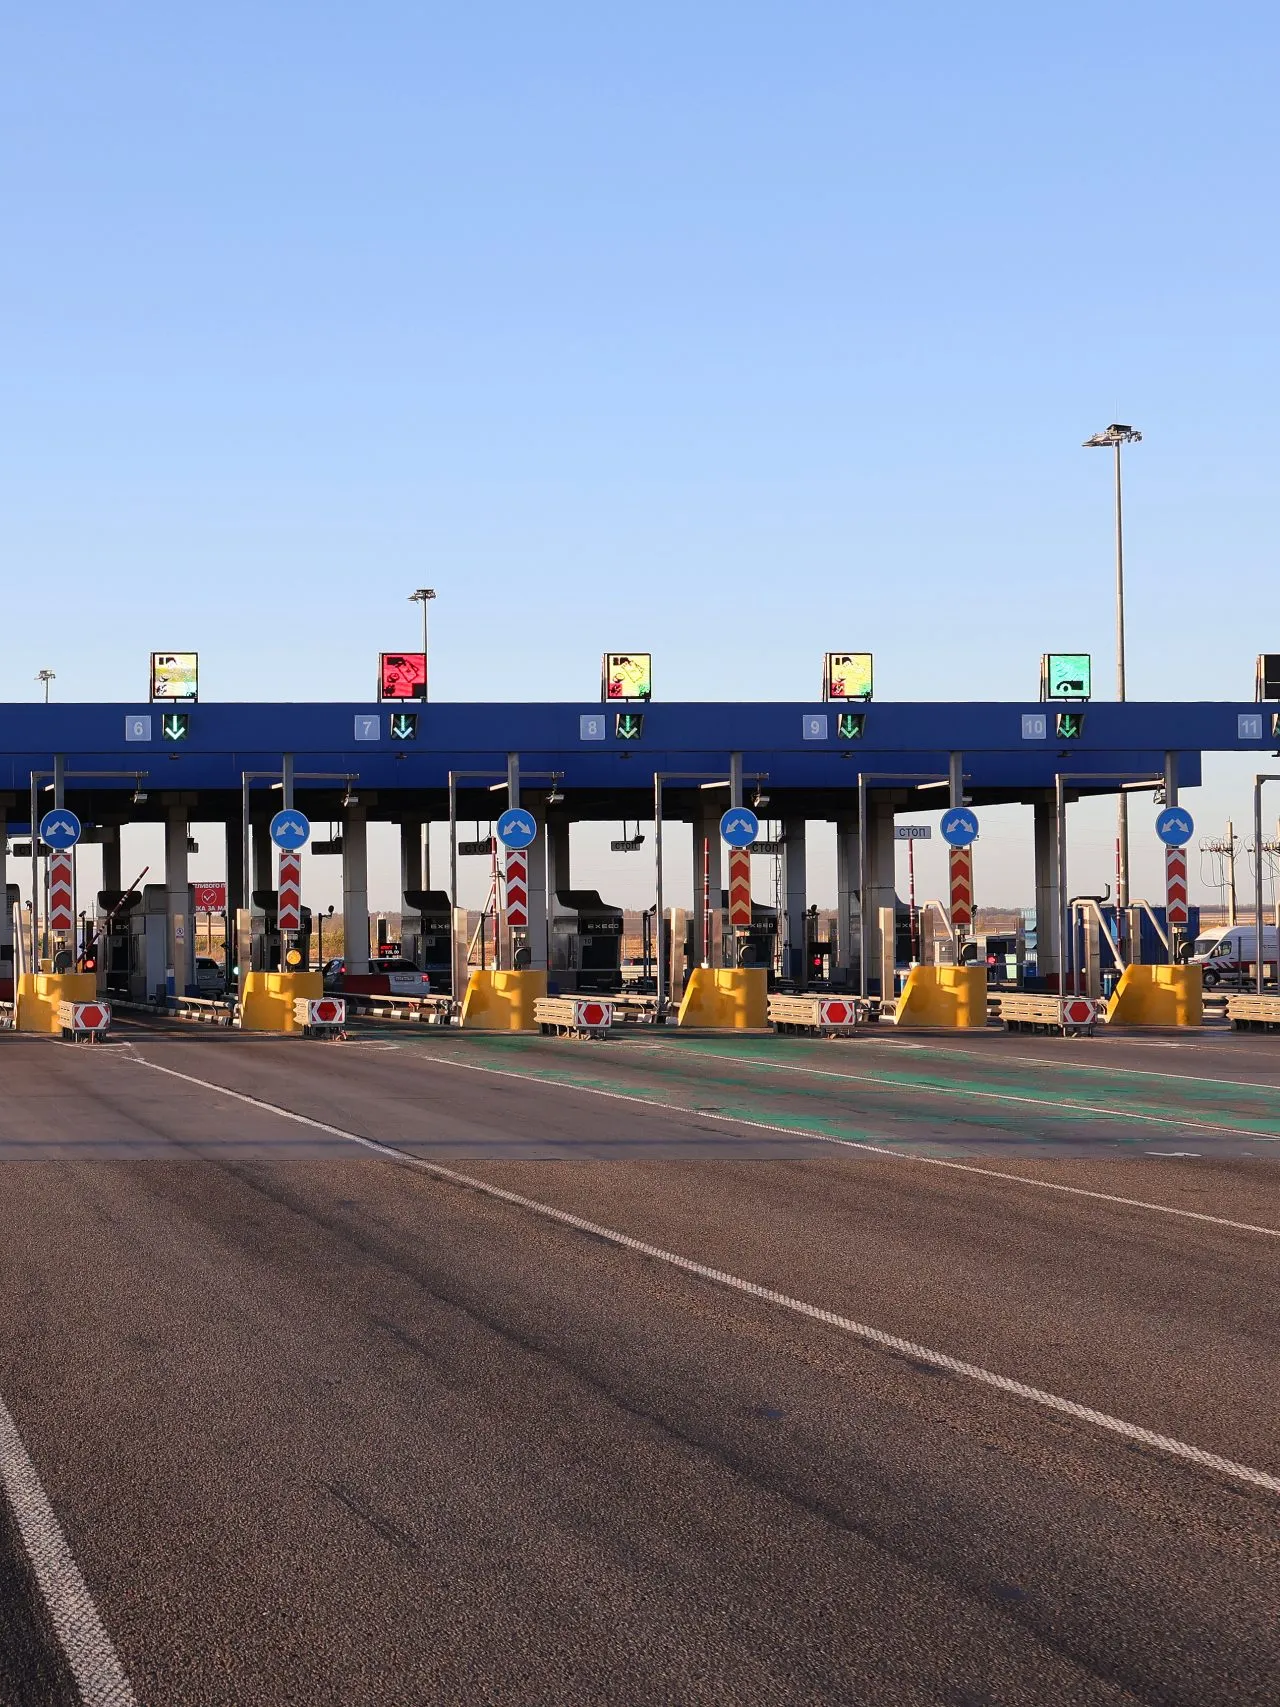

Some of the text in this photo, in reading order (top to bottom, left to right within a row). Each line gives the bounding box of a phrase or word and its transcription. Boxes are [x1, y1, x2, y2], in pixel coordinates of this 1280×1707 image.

[133, 722, 143, 736] 6
[362, 721, 372, 736] 7
[588, 720, 597, 735] 8
[810, 720, 820, 734] 9
[1025, 720, 1043, 734] 10
[1241, 720, 1257, 734] 11
[899, 828, 926, 837] СТОП
[615, 842, 637, 850] СТОП
[752, 843, 779, 852] СТОП
